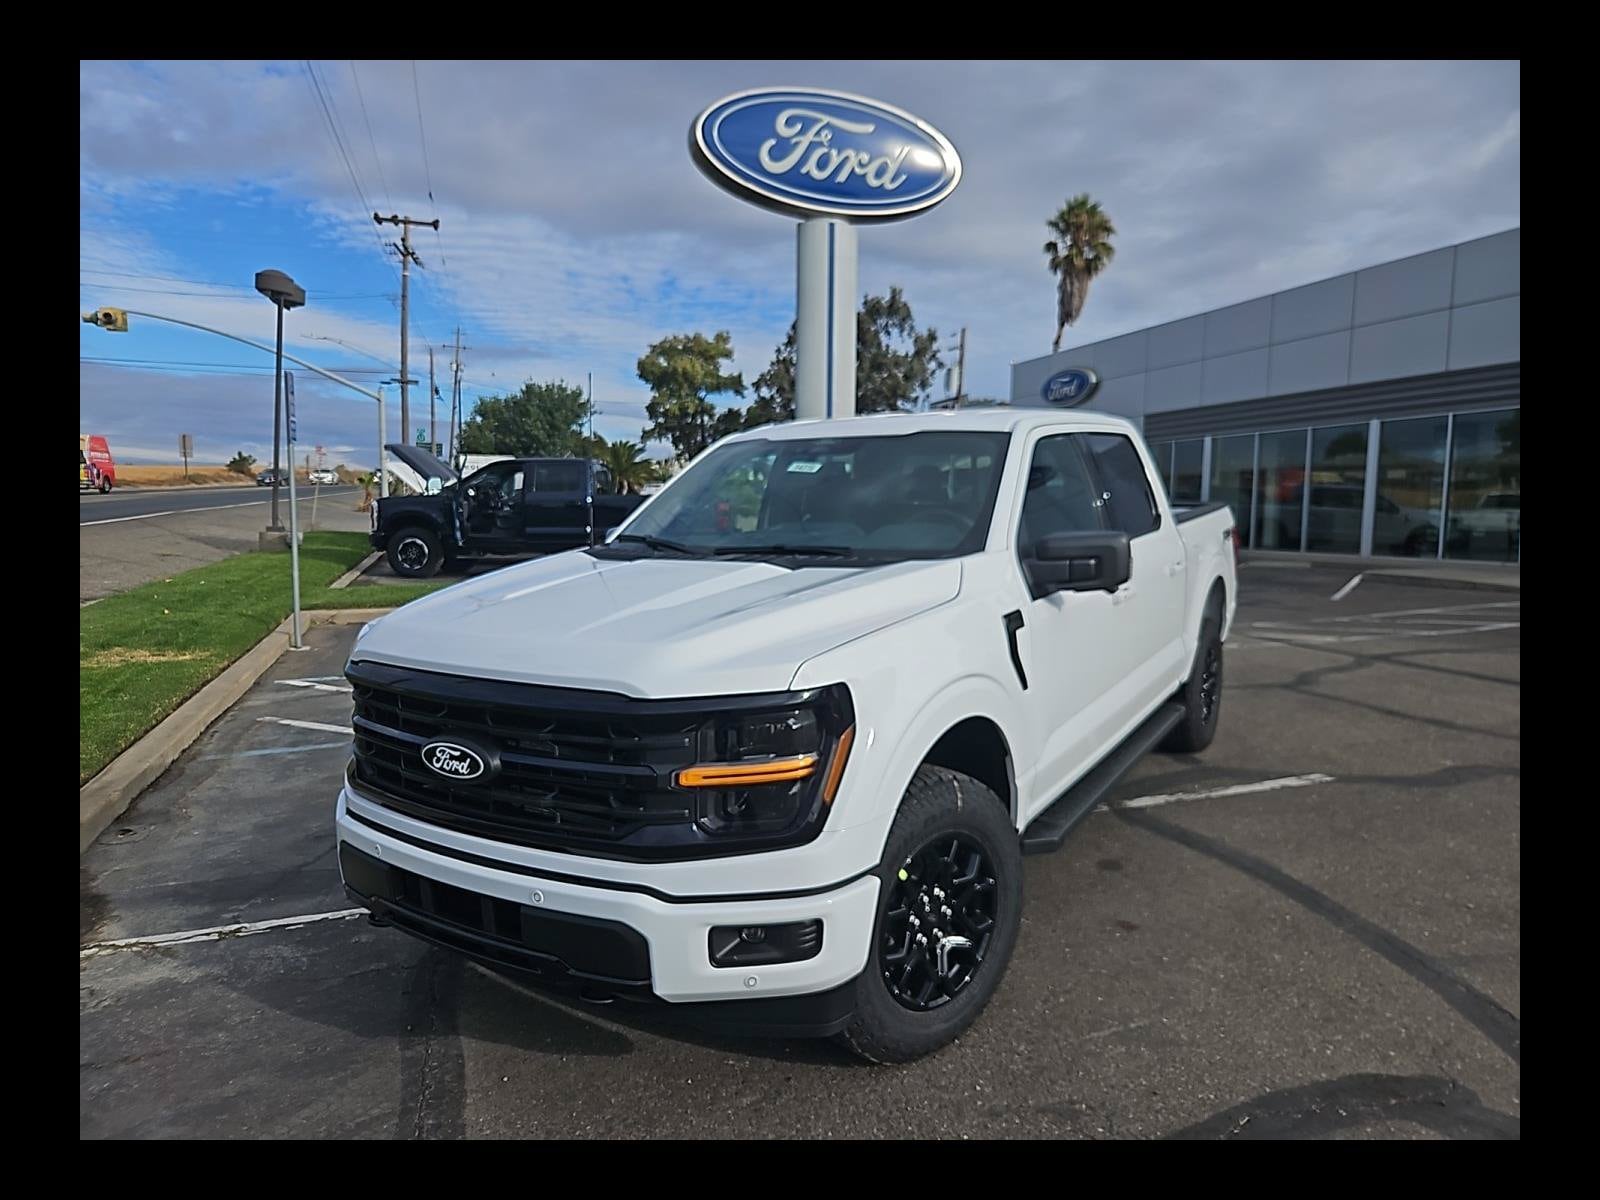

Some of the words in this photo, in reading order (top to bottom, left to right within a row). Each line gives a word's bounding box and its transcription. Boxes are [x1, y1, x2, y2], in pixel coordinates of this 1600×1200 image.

[759, 108, 910, 190] Ford
[1047, 377, 1077, 401] Ford
[432, 746, 471, 775] Ford
